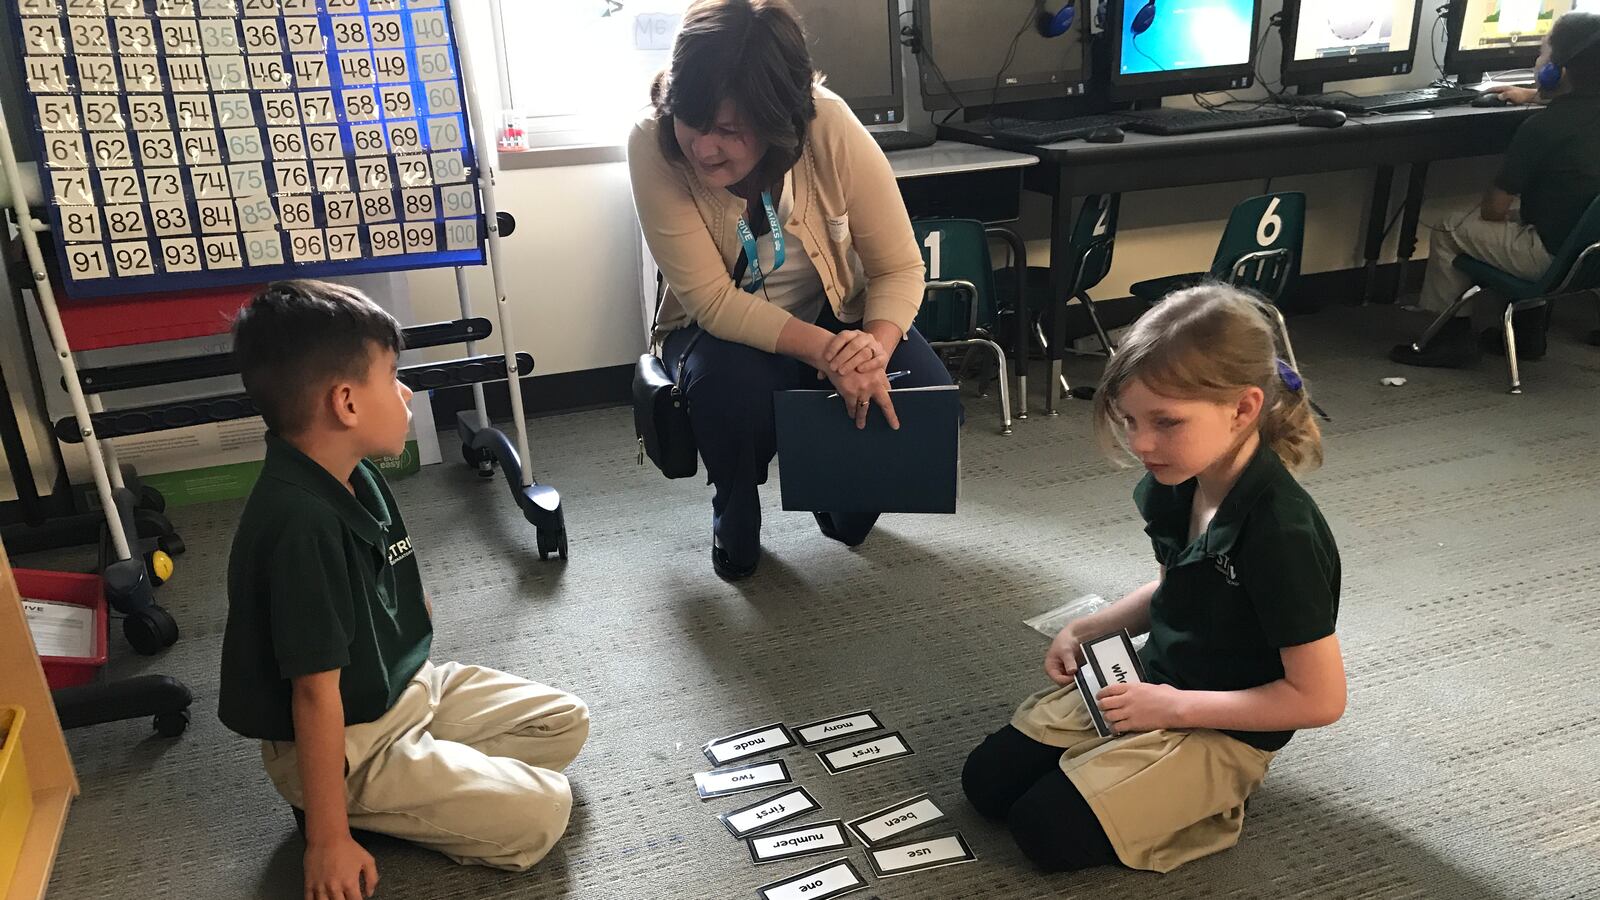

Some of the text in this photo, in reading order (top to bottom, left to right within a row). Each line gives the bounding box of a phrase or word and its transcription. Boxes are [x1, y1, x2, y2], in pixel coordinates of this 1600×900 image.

[29, 18, 443, 47] 31 32 33 34 35 36 37 38 39 40
[30, 54, 447, 84] 41 42 43 44 45 46 47 48 49 50
[45, 88, 456, 124] 51 52 53 54 55 56 57 58 59 60
[52, 123, 457, 161] 61 62 63 64 65 66 67 68 69 70
[57, 158, 461, 198] 71 72 73 74 75 76 77 78 79 80
[68, 193, 473, 234] 81 82 83 84 85 86 87 88 89 90
[765, 204, 780, 239] STRIVE
[1092, 194, 1111, 236] 2
[1256, 197, 1282, 246] 6
[73, 224, 475, 271] 91 92 93 94 95 96 97 98 99 100
[924, 231, 941, 278] 1
[824, 722, 853, 732] many
[734, 737, 765, 750] made
[852, 745, 880, 758] first
[732, 774, 755, 782] two
[756, 803, 785, 819] first
[885, 812, 917, 826] been
[773, 833, 824, 848] number
[907, 848, 931, 857] use
[799, 880, 823, 892] one
